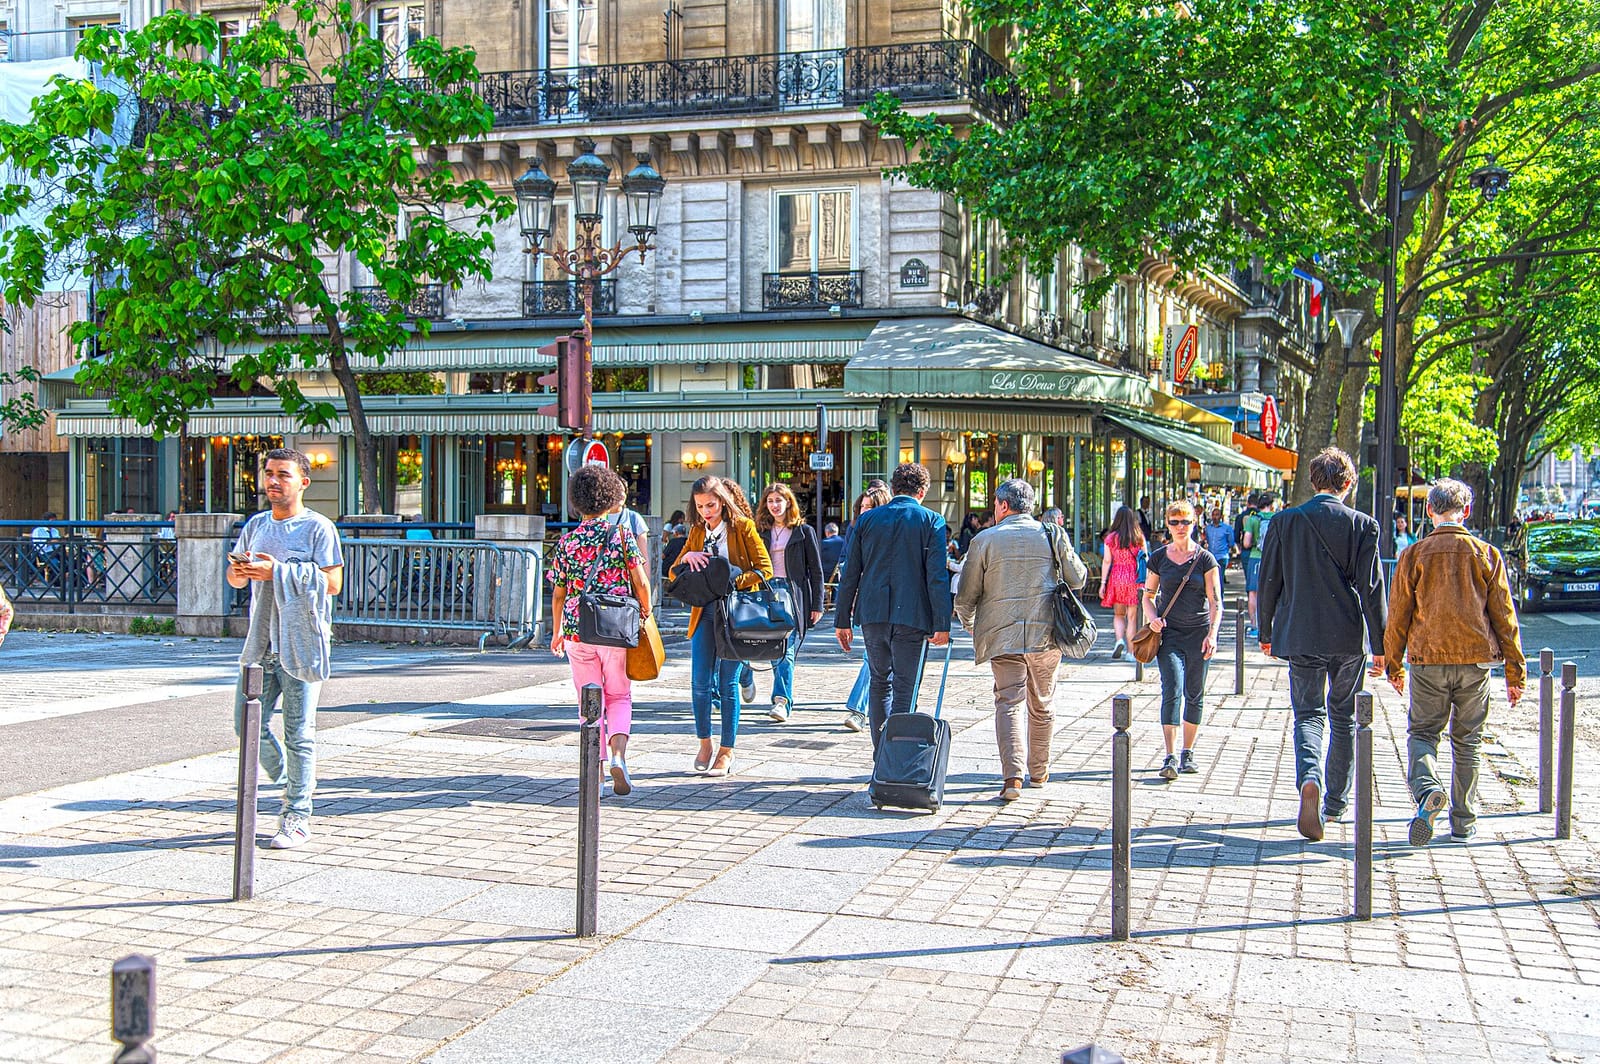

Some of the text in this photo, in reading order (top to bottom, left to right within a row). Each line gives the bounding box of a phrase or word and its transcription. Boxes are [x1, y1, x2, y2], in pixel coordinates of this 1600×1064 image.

[1180, 339, 1192, 369] TABAC
[989, 372, 1016, 390] Les
[1018, 373, 1056, 391] Deux
[1265, 401, 1273, 444] TABAC
